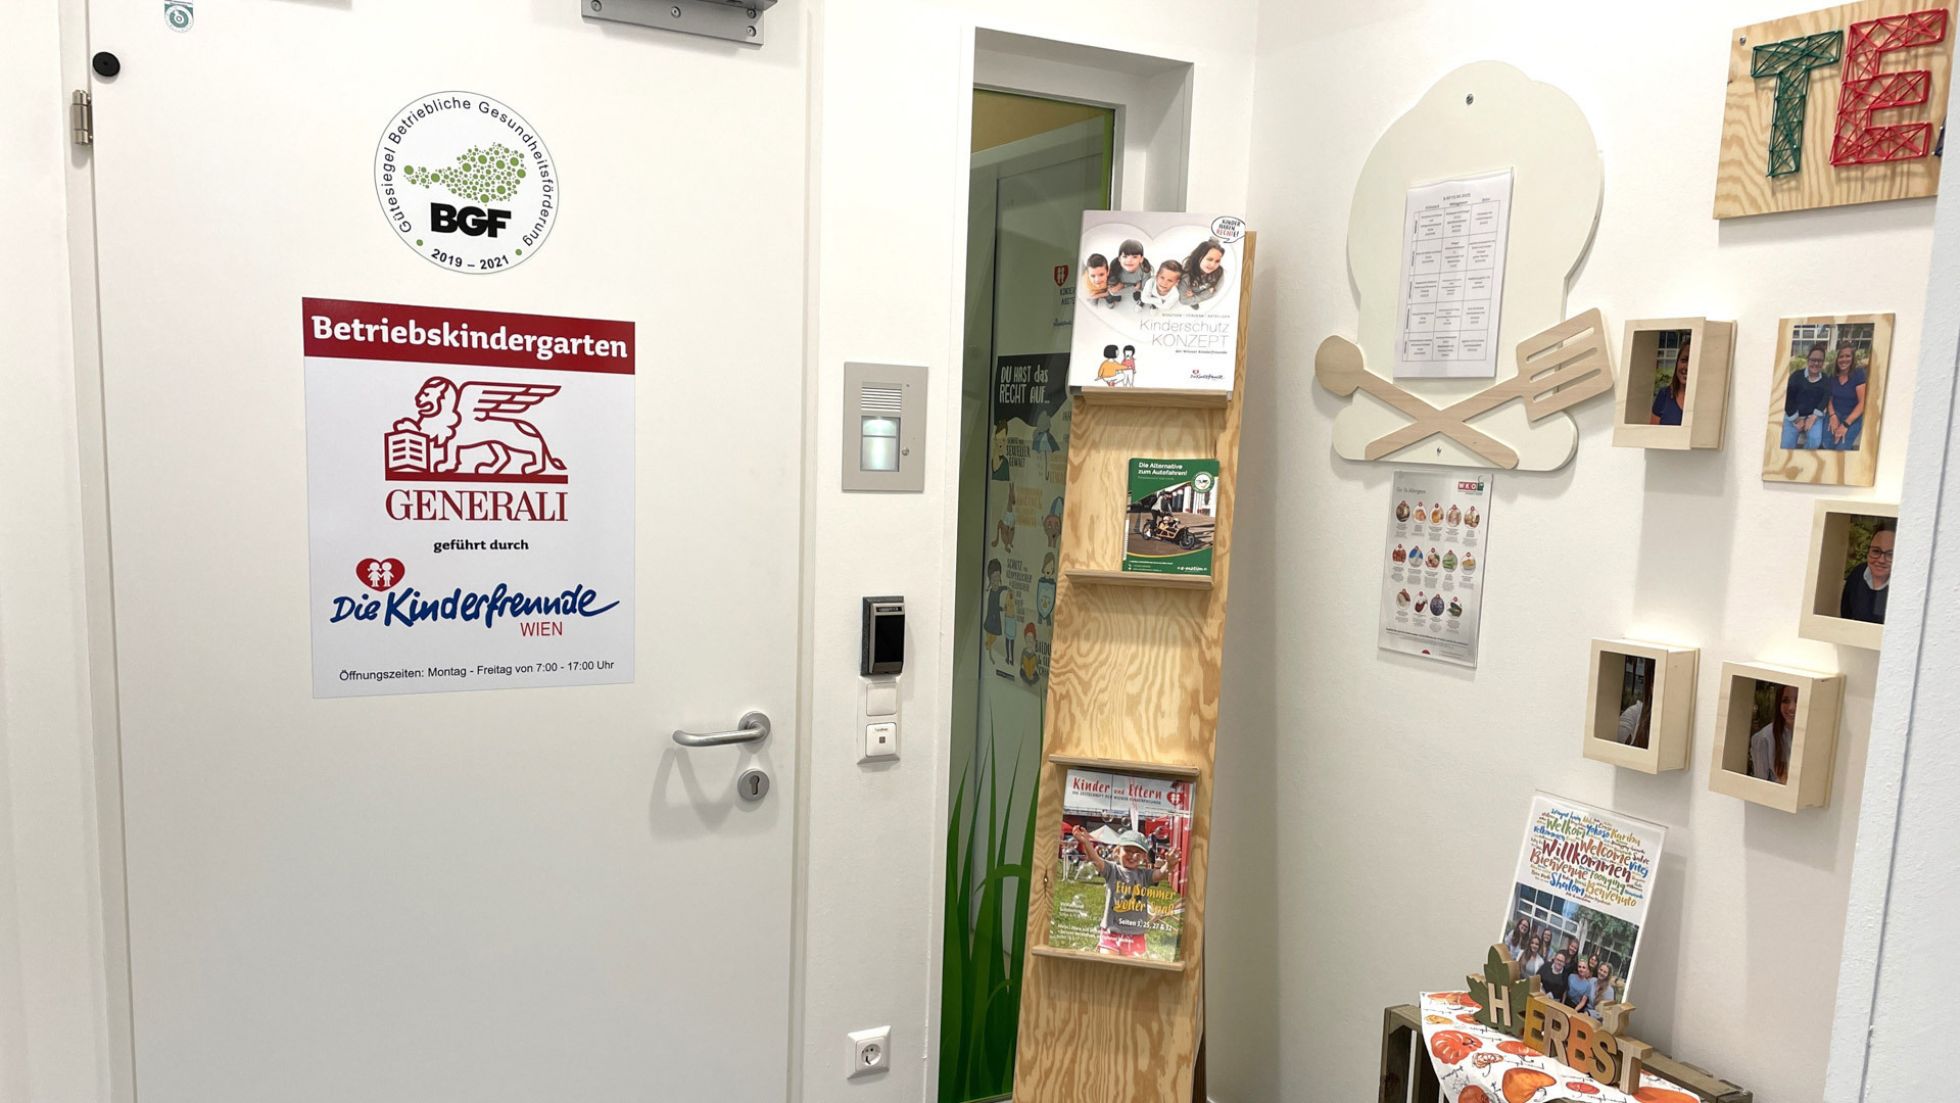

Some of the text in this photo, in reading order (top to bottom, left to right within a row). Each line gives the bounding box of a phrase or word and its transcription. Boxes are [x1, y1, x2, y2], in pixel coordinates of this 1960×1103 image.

[1750, 8, 1948, 178] TE
[381, 97, 554, 247] Gütesiegel Betriebliche Gesundheitsförderung
[430, 202, 512, 238] BGF
[431, 248, 463, 267] 2019
[480, 255, 509, 270] 2021
[311, 315, 628, 360] Betriebskindergarten
[1140, 319, 1230, 333] Kinderschutz
[1152, 333, 1231, 348] KONZEPT
[1001, 364, 1049, 384] DU HAST das
[999, 383, 1027, 404] RECHT
[385, 489, 568, 522] GENERALI
[433, 539, 529, 553] geführt durch
[330, 583, 620, 629] Die Kinderfreunde
[520, 621, 563, 637] WIEN
[339, 668, 424, 682] Öffnungszeiten:
[427, 667, 467, 680] Montag
[477, 664, 513, 676] Freitag
[515, 664, 534, 674] von
[536, 662, 558, 673] 7:00
[567, 660, 595, 672] 17:00
[597, 660, 614, 671] Uhr
[1072, 777, 1110, 793] Kinder
[1128, 783, 1162, 800] Eltern
[1546, 818, 1586, 839] Welkom
[1542, 839, 1632, 884] Willkommen
[1580, 837, 1631, 866] Welcome
[1530, 847, 1588, 880] Bienvenue
[1116, 881, 1176, 900] Ein Sommer
[1549, 871, 1585, 896] Shalom
[1585, 880, 1637, 907] Benvenuto
[1113, 898, 1174, 916] voller Spaß
[1118, 918, 1136, 927] Seiten
[1487, 982, 1644, 1095] HERBST
